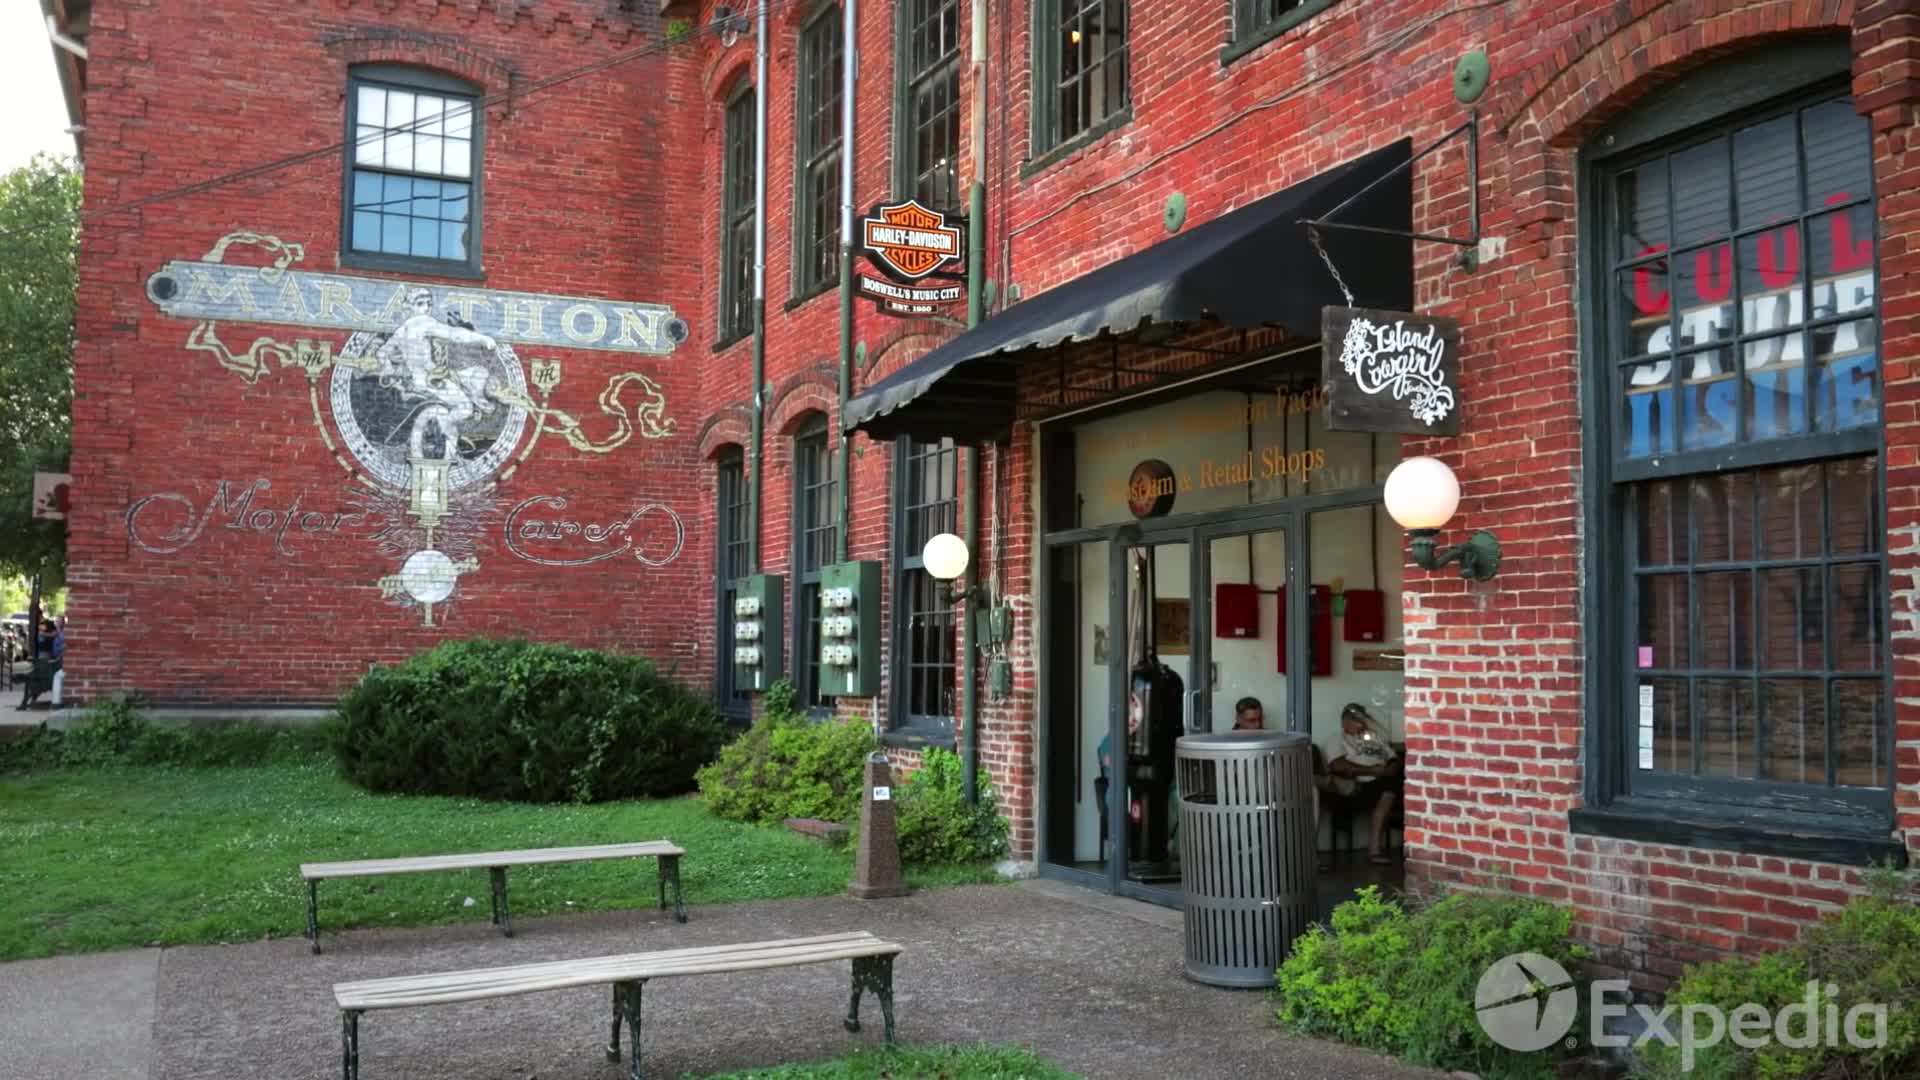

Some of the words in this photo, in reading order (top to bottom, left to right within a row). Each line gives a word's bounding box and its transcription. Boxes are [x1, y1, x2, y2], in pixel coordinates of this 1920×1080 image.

[871, 226, 952, 250] HARLEY-DAVIDSON
[891, 212, 935, 229] MOTOR
[890, 248, 934, 271] CYCLES
[1632, 191, 1874, 315] COOL
[186, 268, 662, 349] MARATHON
[862, 277, 911, 300] BOSWELL'S
[911, 289, 940, 301] MUSIC
[940, 286, 960, 300] CITY
[1370, 320, 1436, 353] Island
[1630, 271, 1874, 386] STUFF
[1354, 338, 1445, 400] Cowgirl
[1628, 353, 1879, 458] INSIDE
[1200, 451, 1254, 489] Retail
[1260, 445, 1325, 482] Shops
[126, 479, 364, 556] Motor
